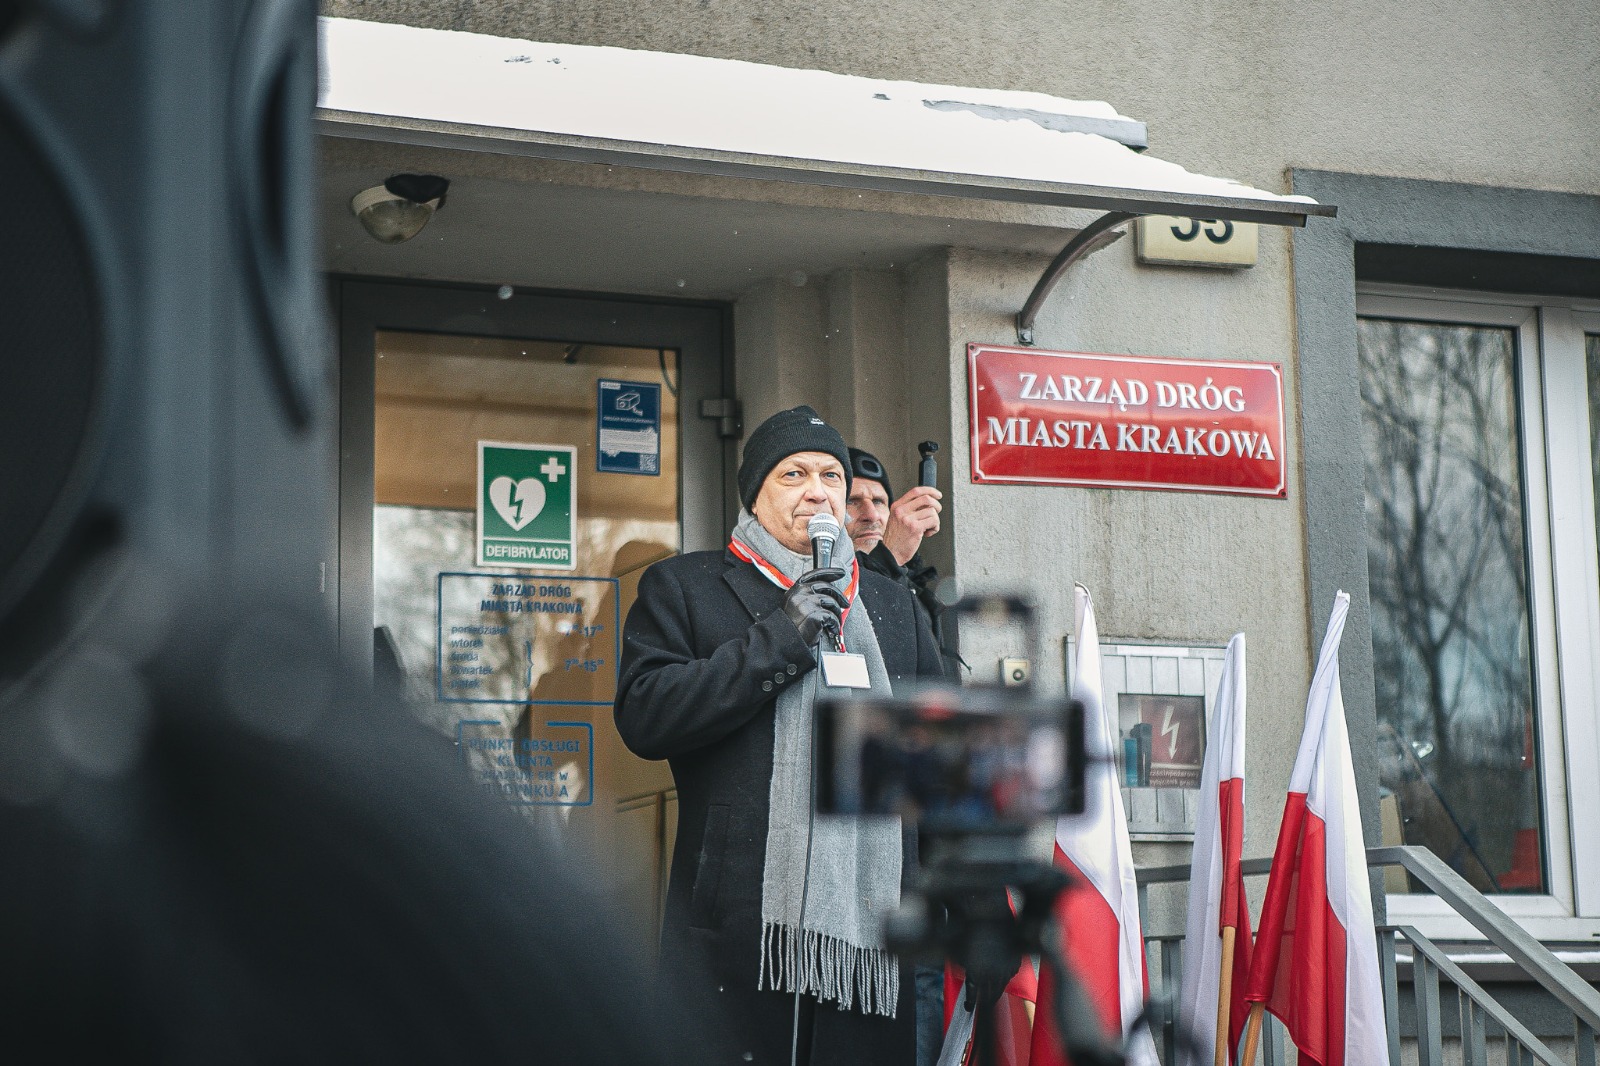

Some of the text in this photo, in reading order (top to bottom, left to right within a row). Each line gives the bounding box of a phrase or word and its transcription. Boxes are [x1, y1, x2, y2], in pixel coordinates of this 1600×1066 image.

[1019, 372, 1246, 412] ZARZĄD DRÓG
[987, 416, 1275, 461] MIASTA KRAKOWA
[486, 545, 568, 560] DEFIBRYLATOR
[539, 584, 571, 597] DRÓG
[481, 600, 583, 614] MIASTA KRAKOWA
[558, 785, 569, 797] A
